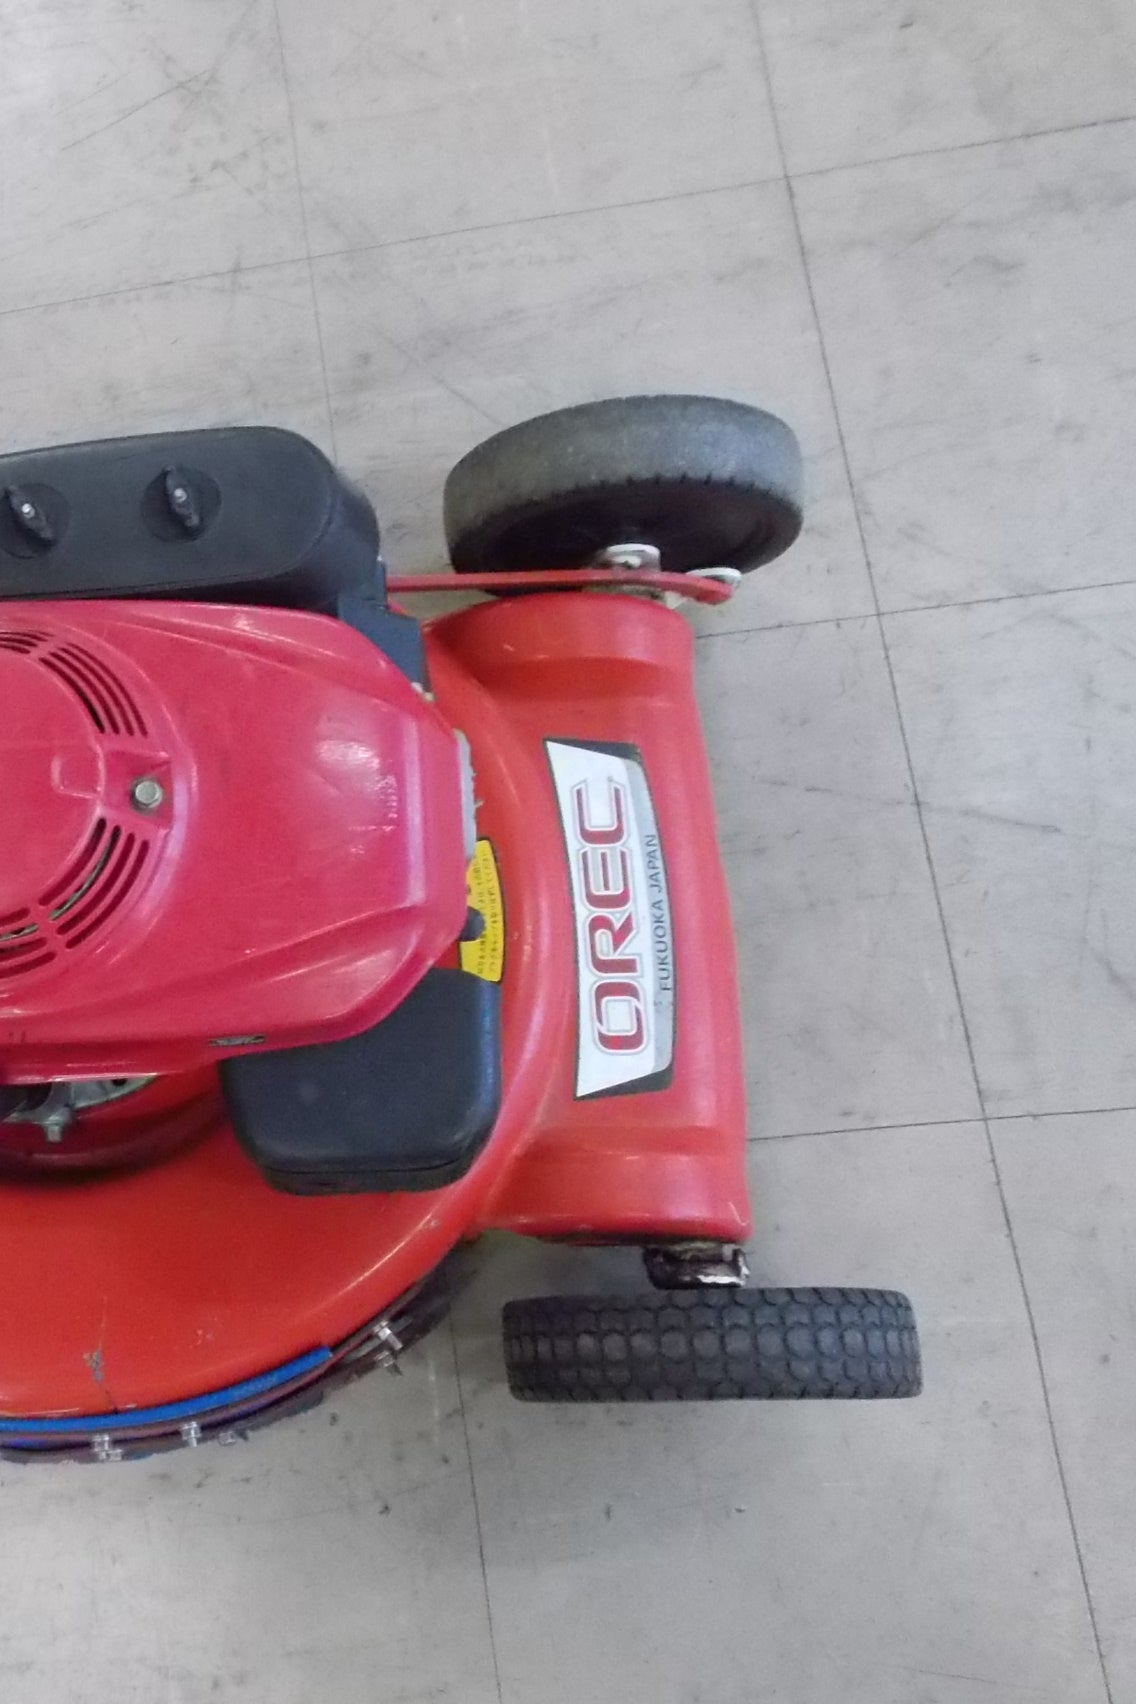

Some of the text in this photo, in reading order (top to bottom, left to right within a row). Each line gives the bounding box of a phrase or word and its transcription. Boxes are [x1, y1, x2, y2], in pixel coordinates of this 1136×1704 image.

[573, 780, 647, 1053] OREC
[644, 833, 672, 992] FUKUOKA JAPAN
